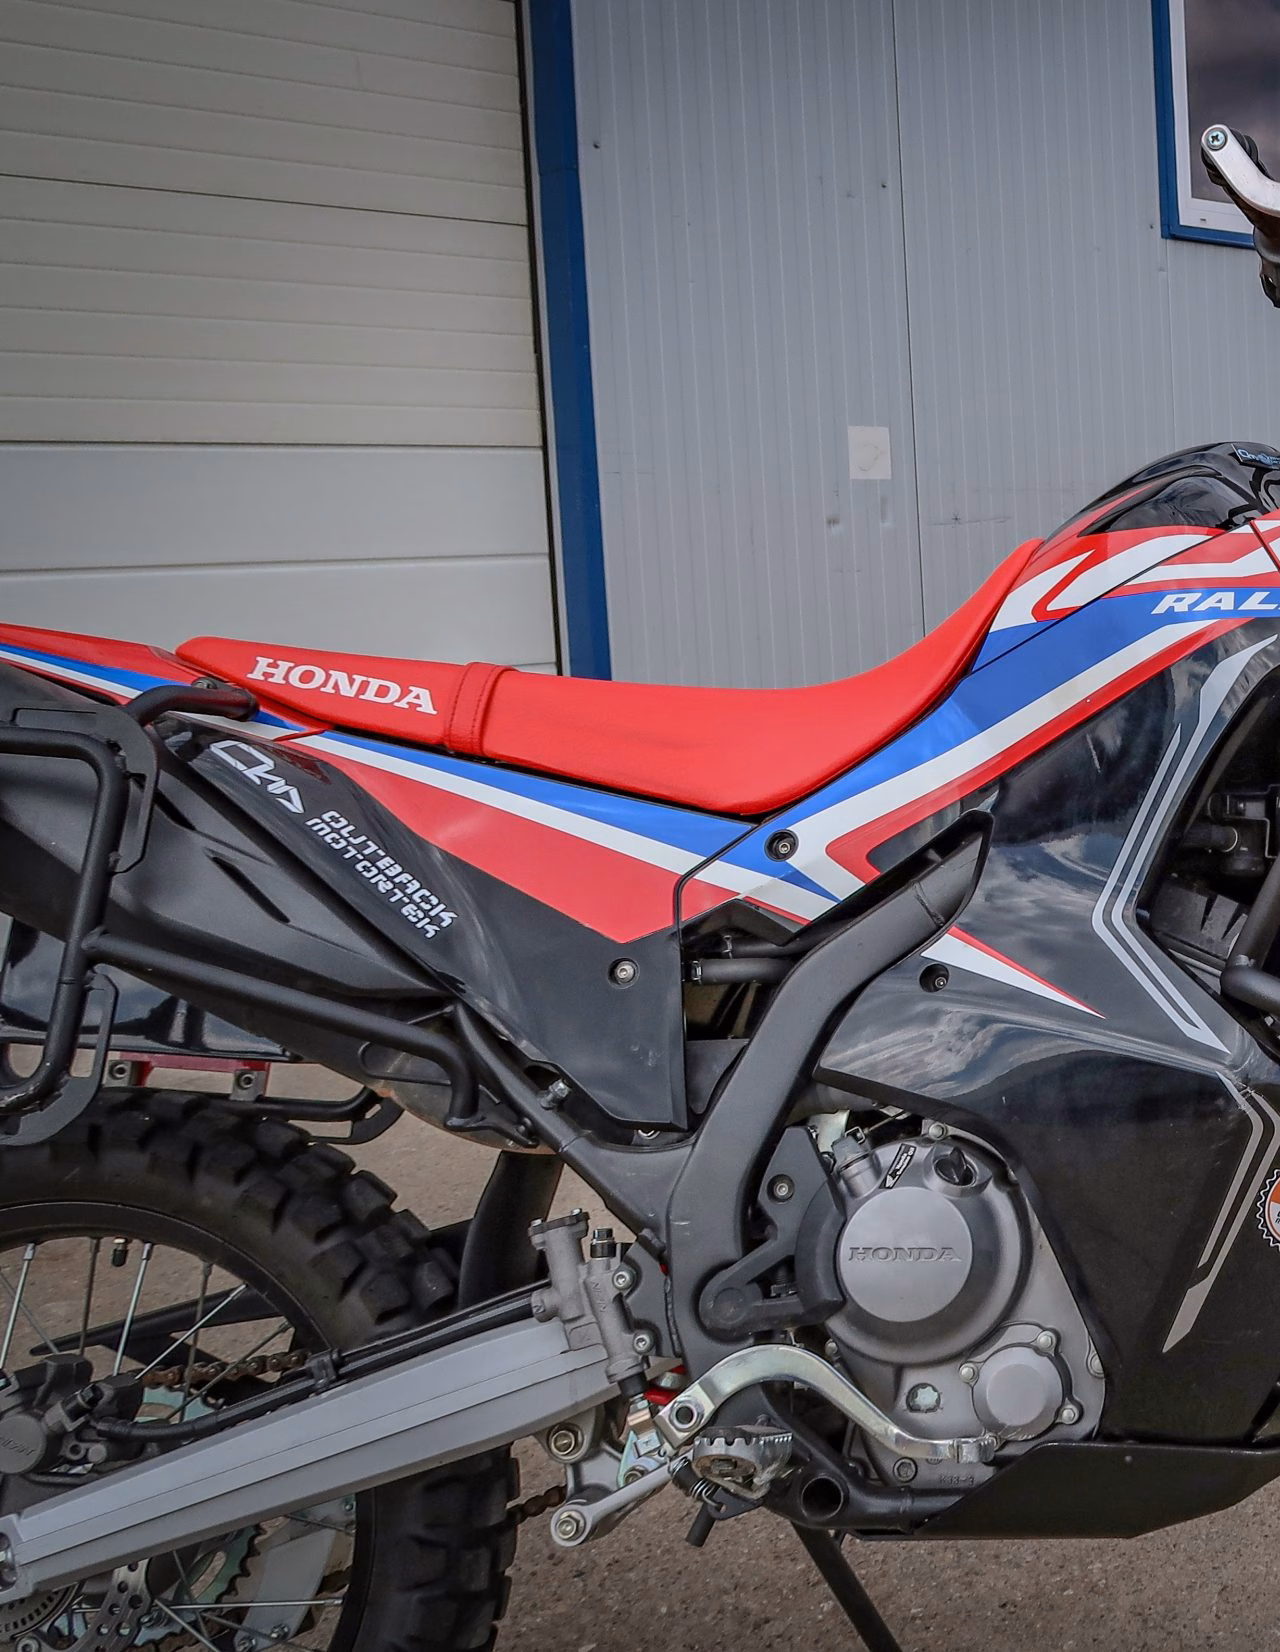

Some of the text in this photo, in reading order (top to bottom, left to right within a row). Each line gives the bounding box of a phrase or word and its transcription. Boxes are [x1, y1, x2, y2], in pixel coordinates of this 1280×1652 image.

[246, 656, 438, 715] HONDA
[305, 817, 441, 939] MOTORTEK
[320, 810, 458, 928] OUTBACK
[848, 1246, 962, 1262] HONDA
